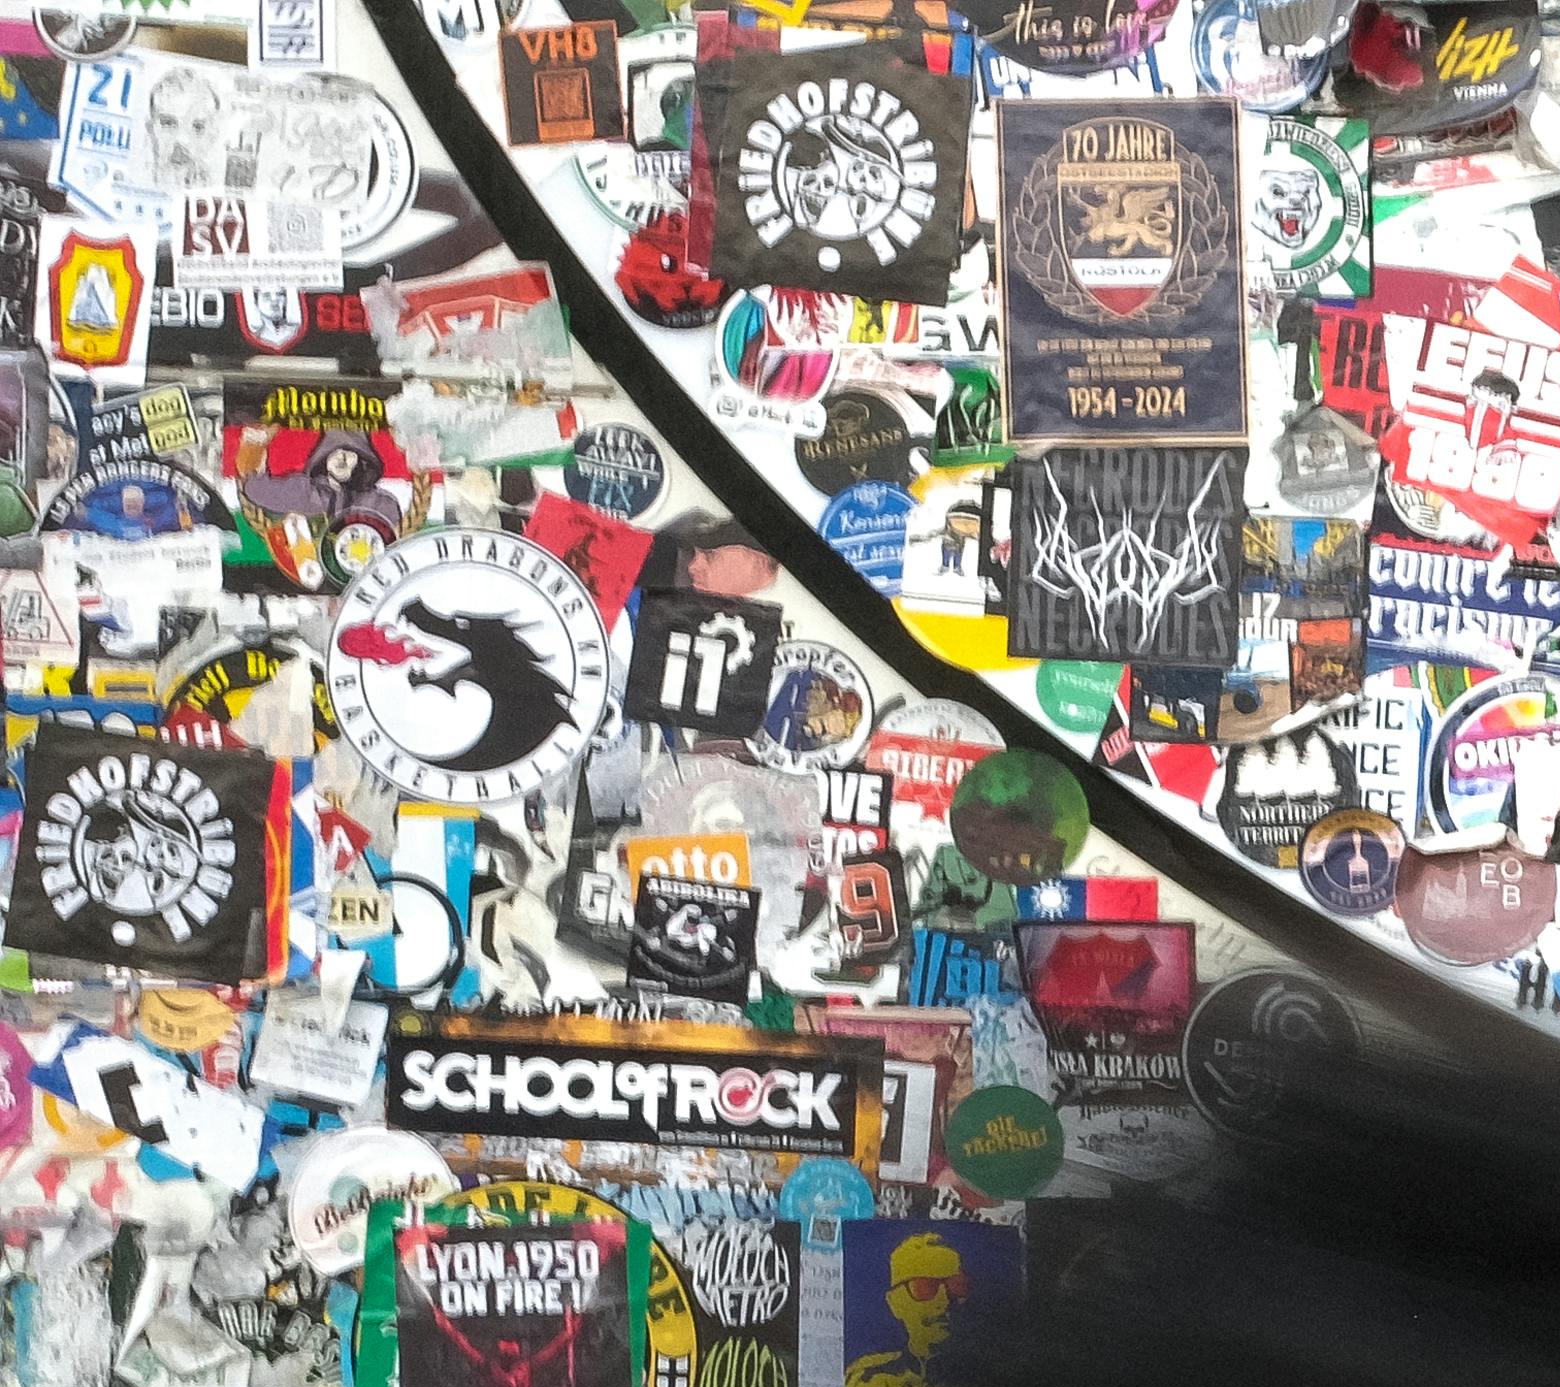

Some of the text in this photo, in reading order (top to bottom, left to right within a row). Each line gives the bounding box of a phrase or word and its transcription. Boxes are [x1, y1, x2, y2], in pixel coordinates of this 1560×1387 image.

[522, 30, 599, 62] VH8
[1072, 130, 1167, 162] 70 JAHRE
[190, 229, 243, 255] SV
[1070, 388, 1185, 416] 1954 2024
[401, 1052, 841, 1130] SCHOOL ROCK
[517, 1240, 600, 1278] 1950
[442, 1278, 562, 1317] ON FIRE
